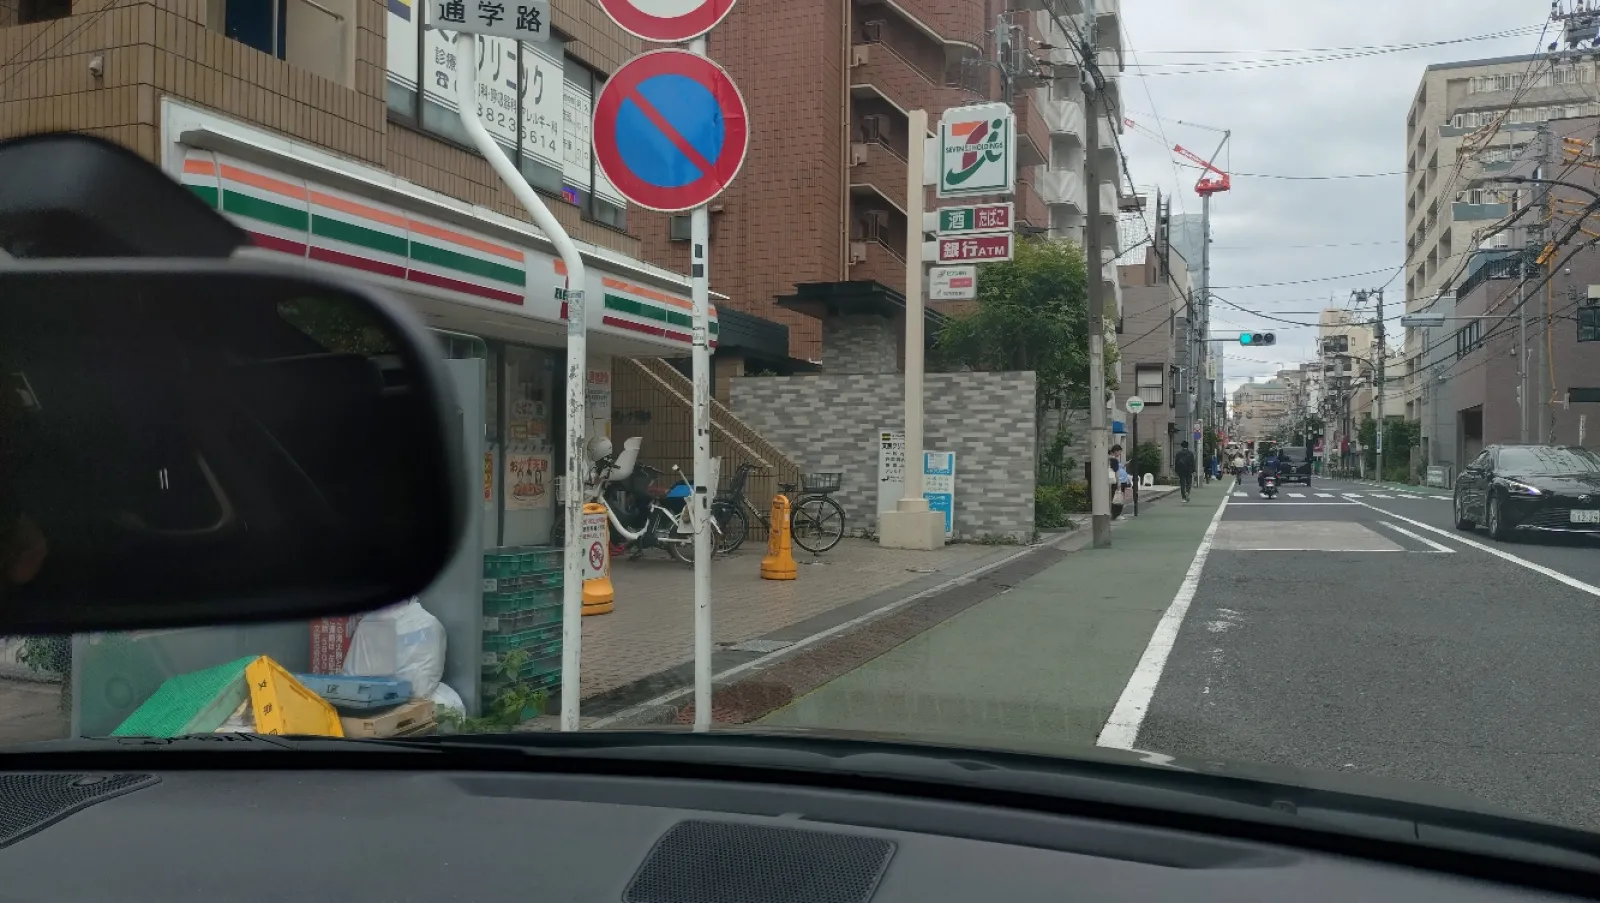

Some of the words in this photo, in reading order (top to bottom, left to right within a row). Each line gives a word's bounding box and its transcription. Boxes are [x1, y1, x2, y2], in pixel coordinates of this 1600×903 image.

[438, 0, 542, 33] 通学路
[948, 211, 966, 230] 酒
[979, 209, 1005, 227] たばこ
